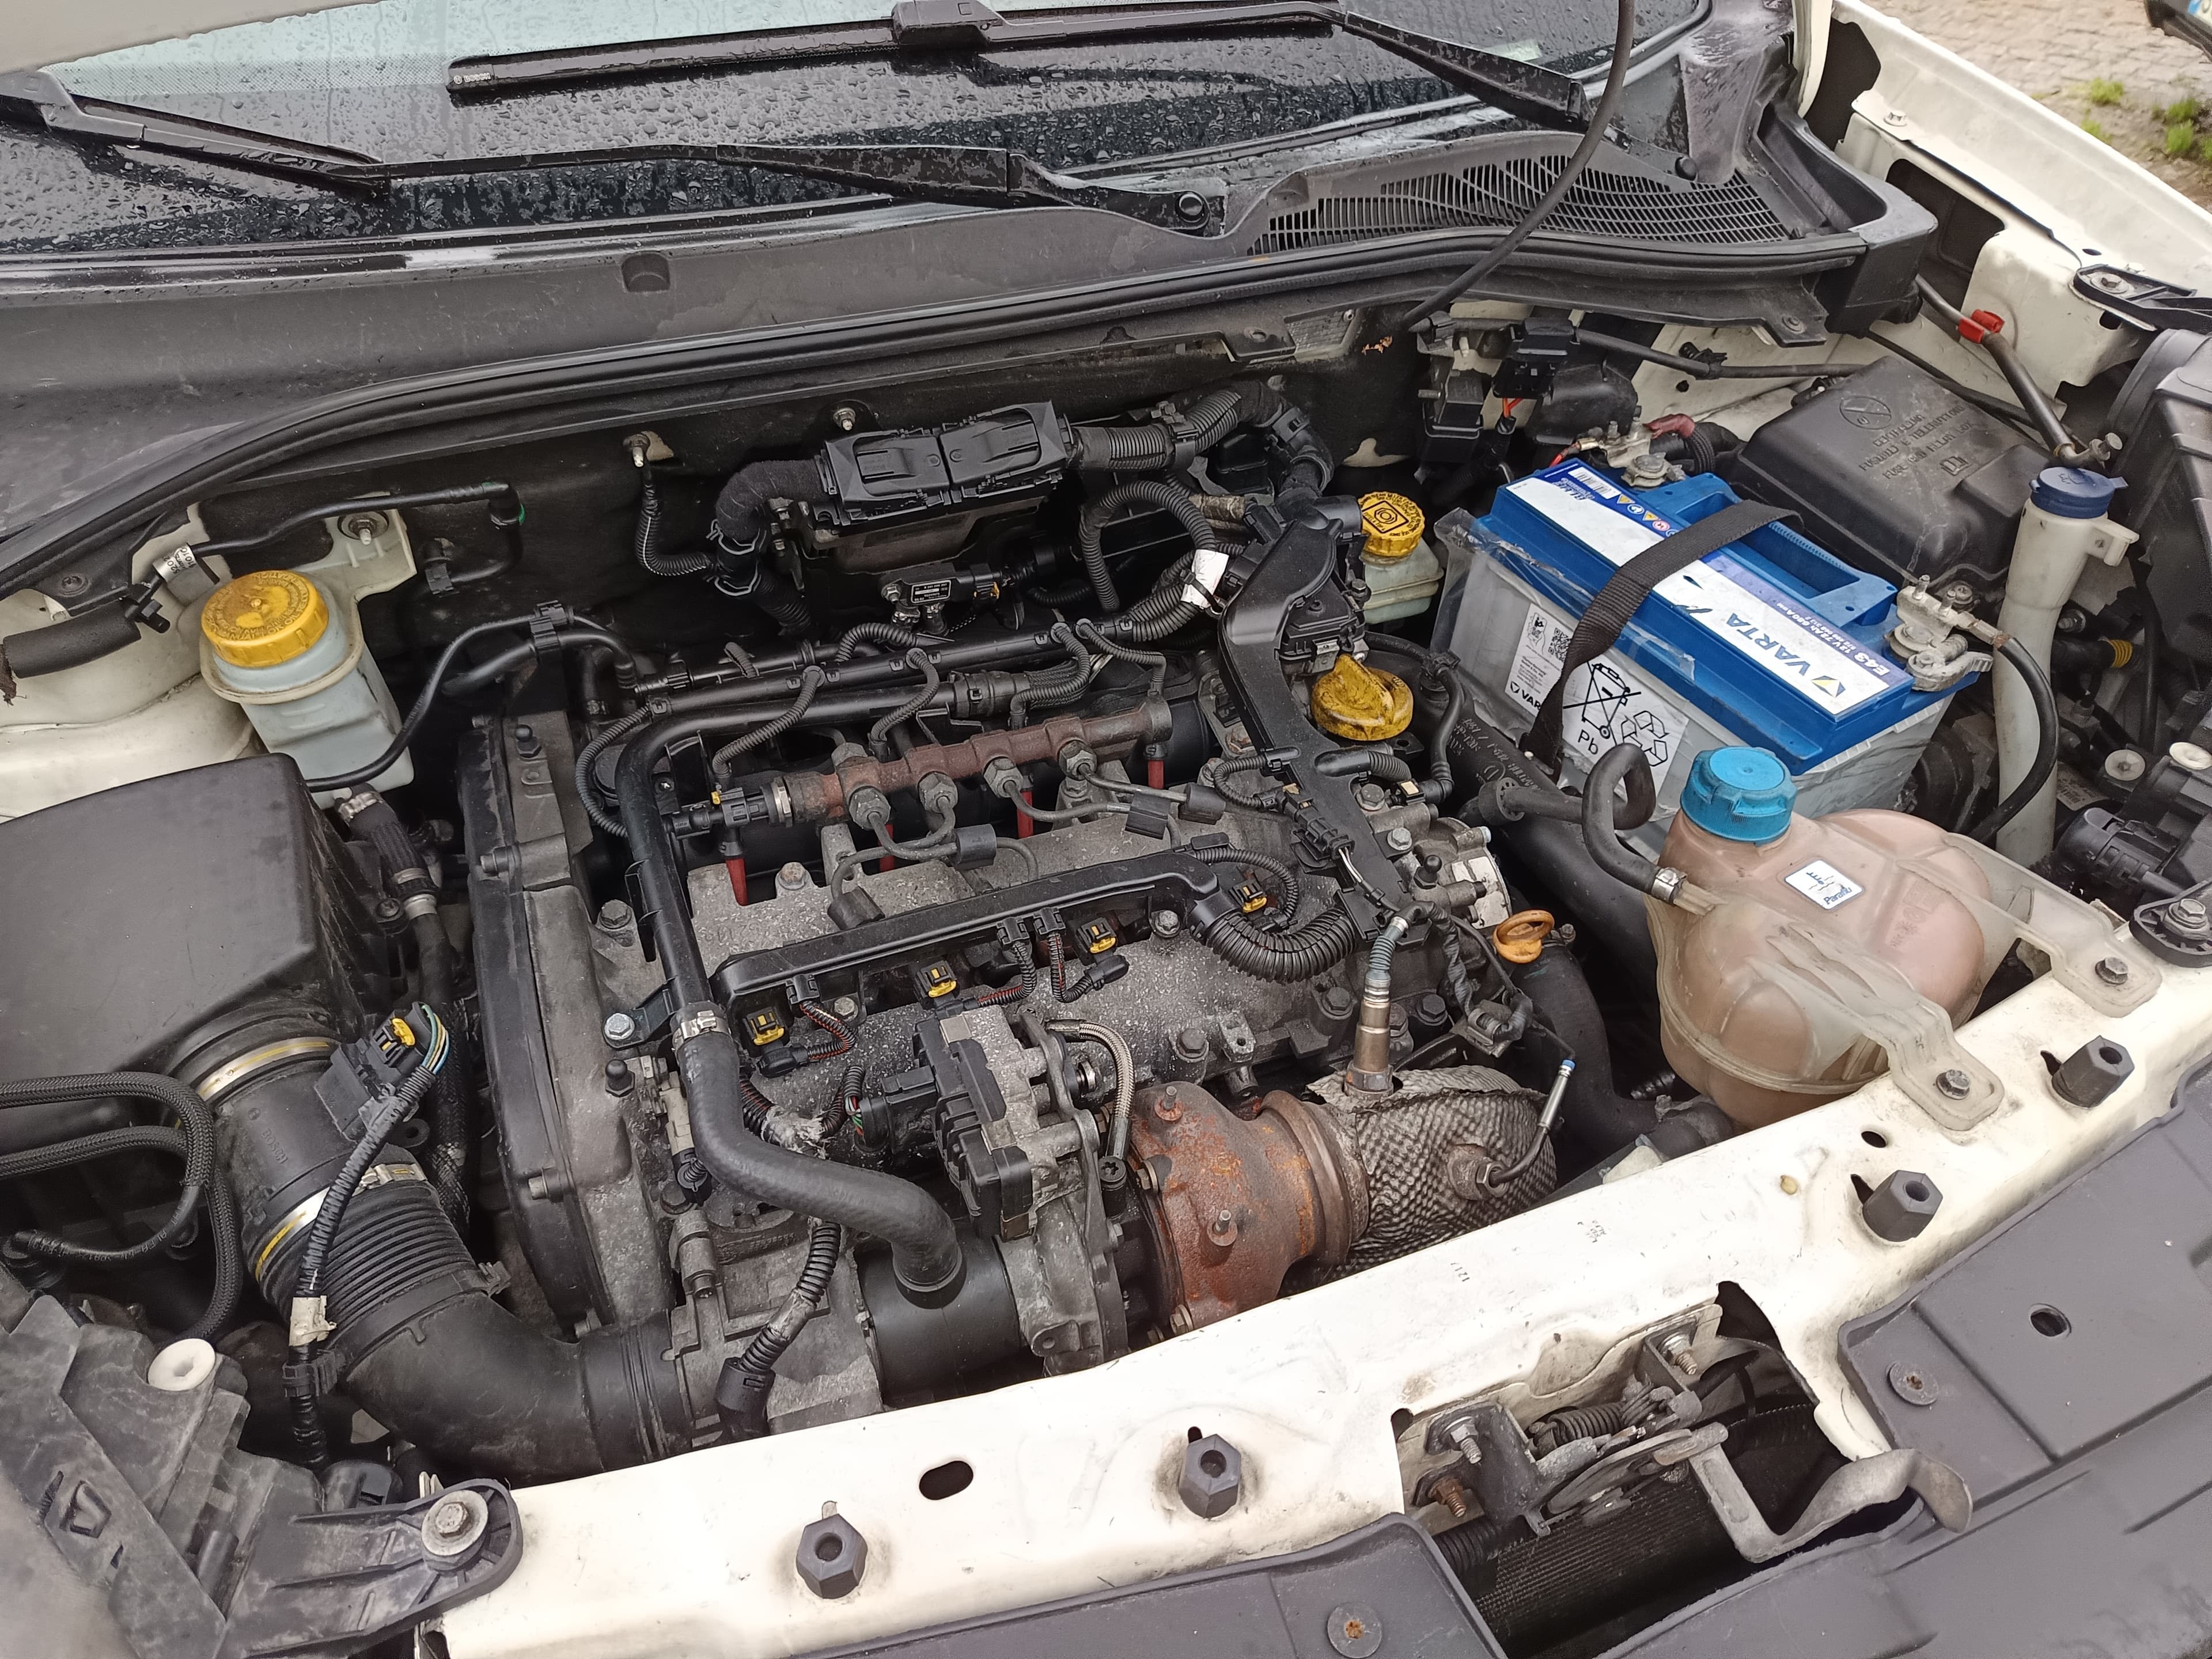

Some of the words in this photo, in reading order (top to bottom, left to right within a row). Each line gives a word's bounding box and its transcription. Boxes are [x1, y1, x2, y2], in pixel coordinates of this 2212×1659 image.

[1726, 612, 1810, 676] VARTA
[1810, 625, 1832, 642] 72Ah
[1832, 641, 1851, 654] 12V
[1854, 652, 1891, 676] E43
[1521, 690, 1542, 710] VAR
[1578, 729, 1599, 755] Pb
